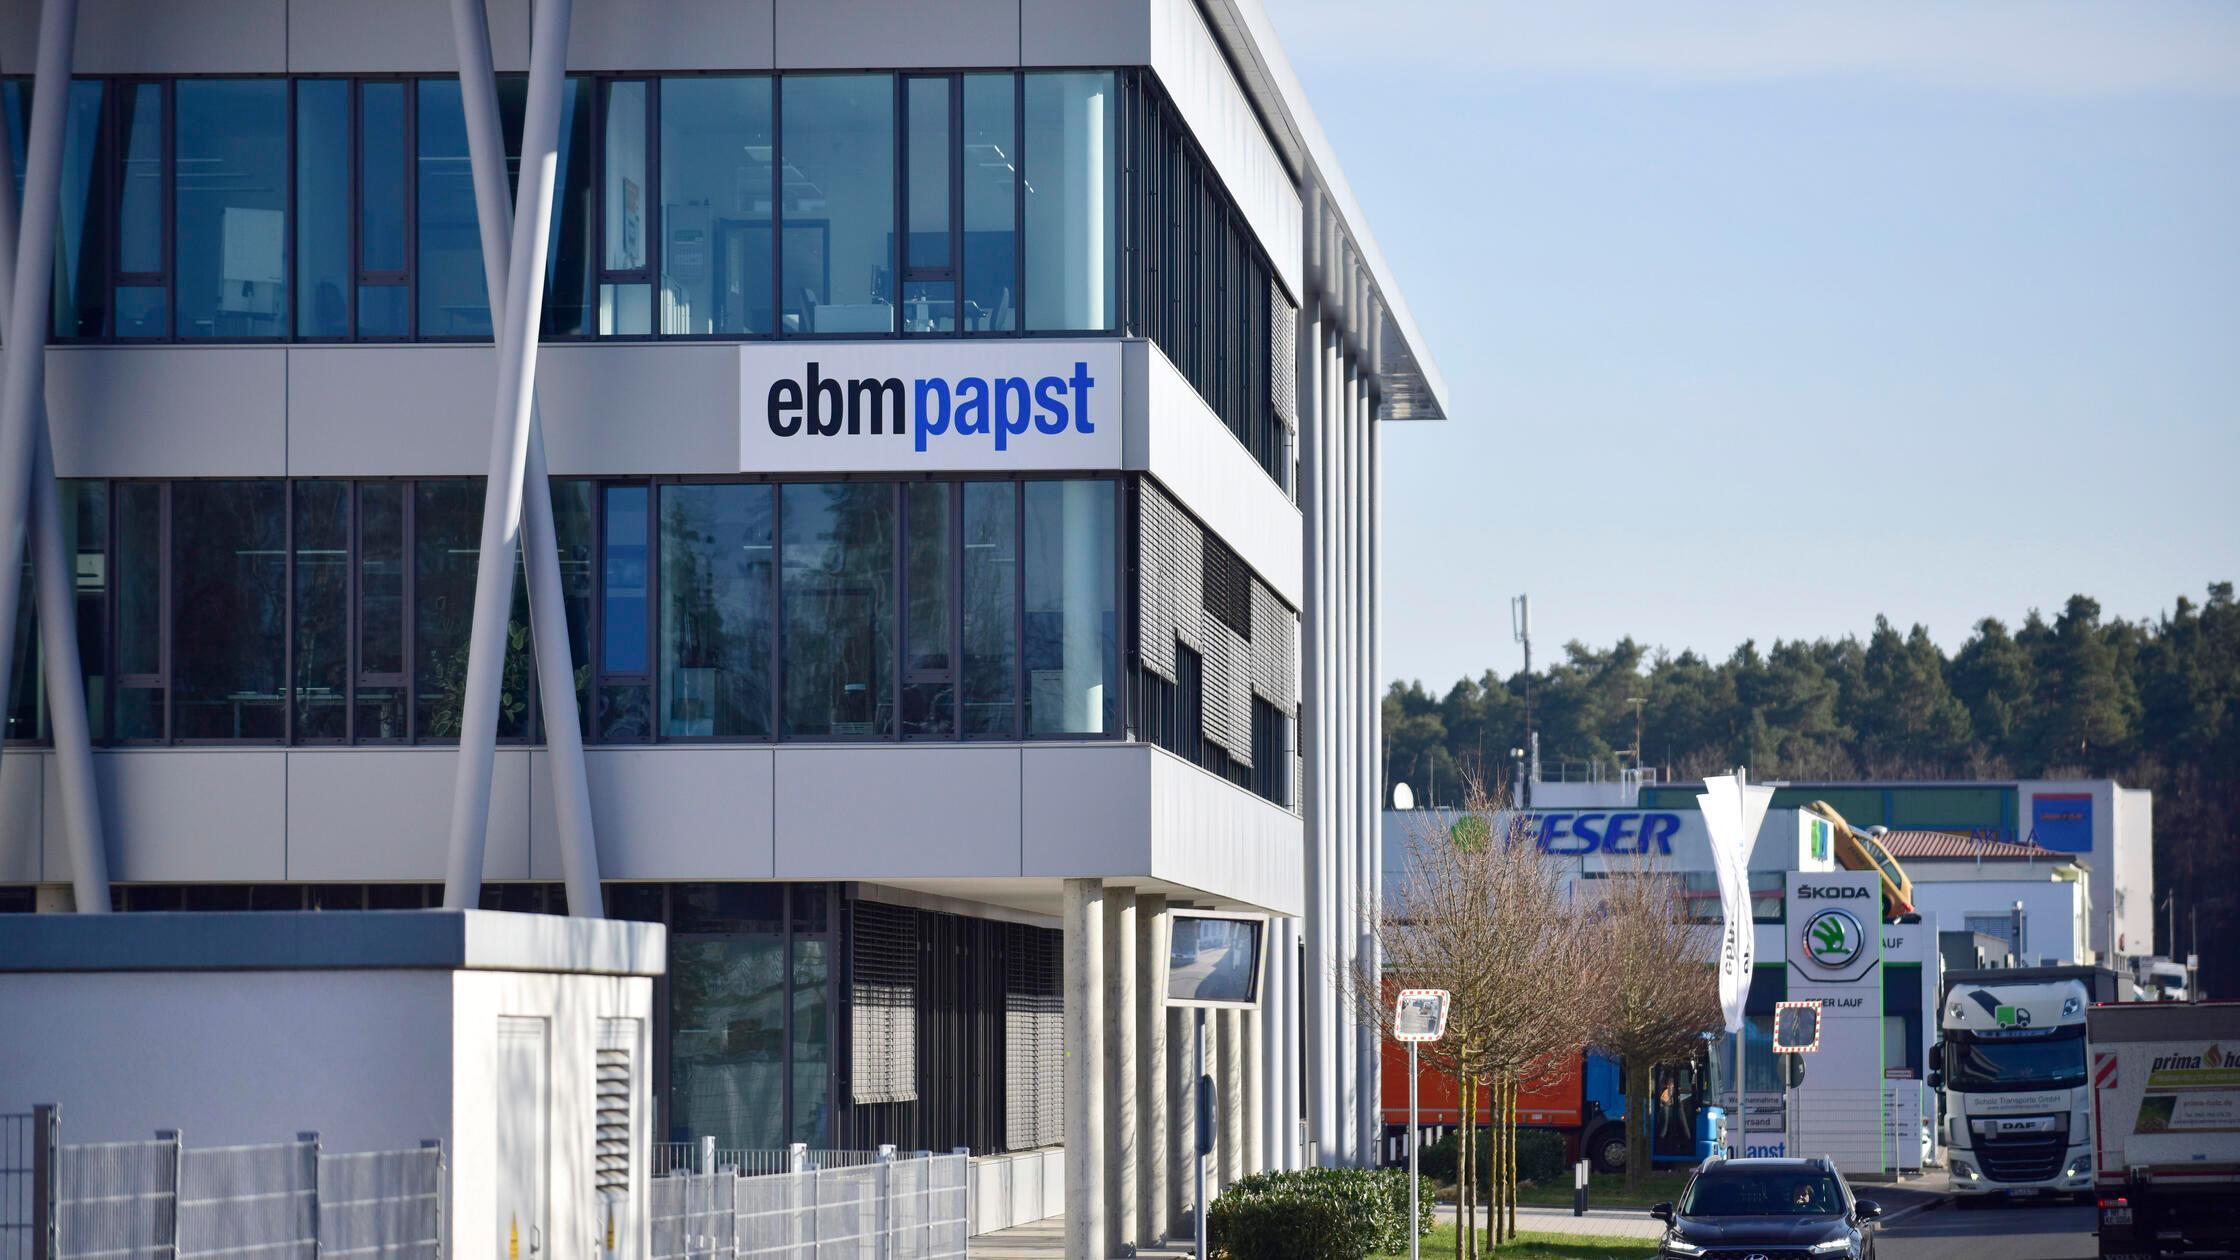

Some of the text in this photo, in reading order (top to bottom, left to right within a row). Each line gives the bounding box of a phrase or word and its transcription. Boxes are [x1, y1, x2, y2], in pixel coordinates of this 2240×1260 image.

[767, 361, 1095, 452] ebmpapst
[1798, 884, 1870, 899] ŠKODA
[1837, 998, 1863, 1007] LAUF
[2151, 1052, 2201, 1073] prima
[2002, 1121, 2036, 1129] DAF
